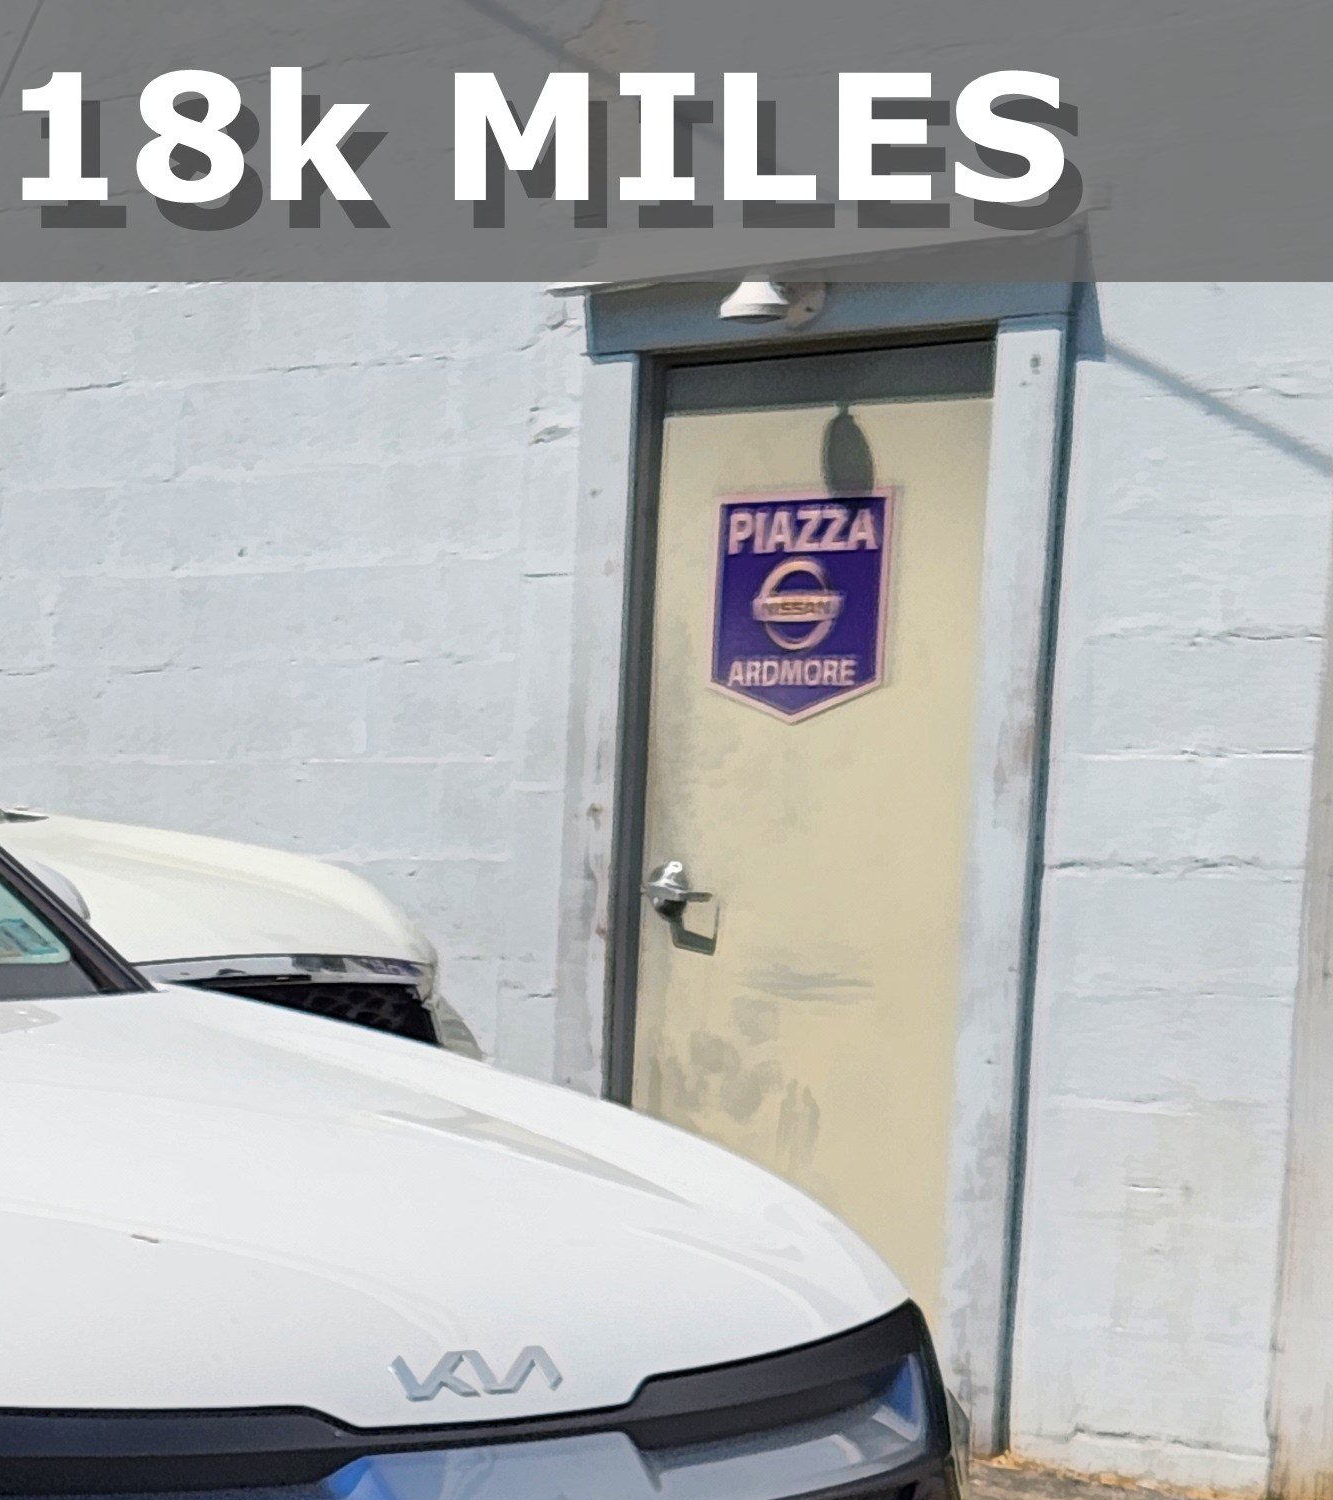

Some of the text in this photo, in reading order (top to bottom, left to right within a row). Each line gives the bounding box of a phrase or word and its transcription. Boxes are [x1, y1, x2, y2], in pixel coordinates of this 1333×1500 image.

[727, 504, 879, 555] PIAZZA
[727, 655, 857, 687] ARDMORE
[387, 1345, 564, 1402] KIA
